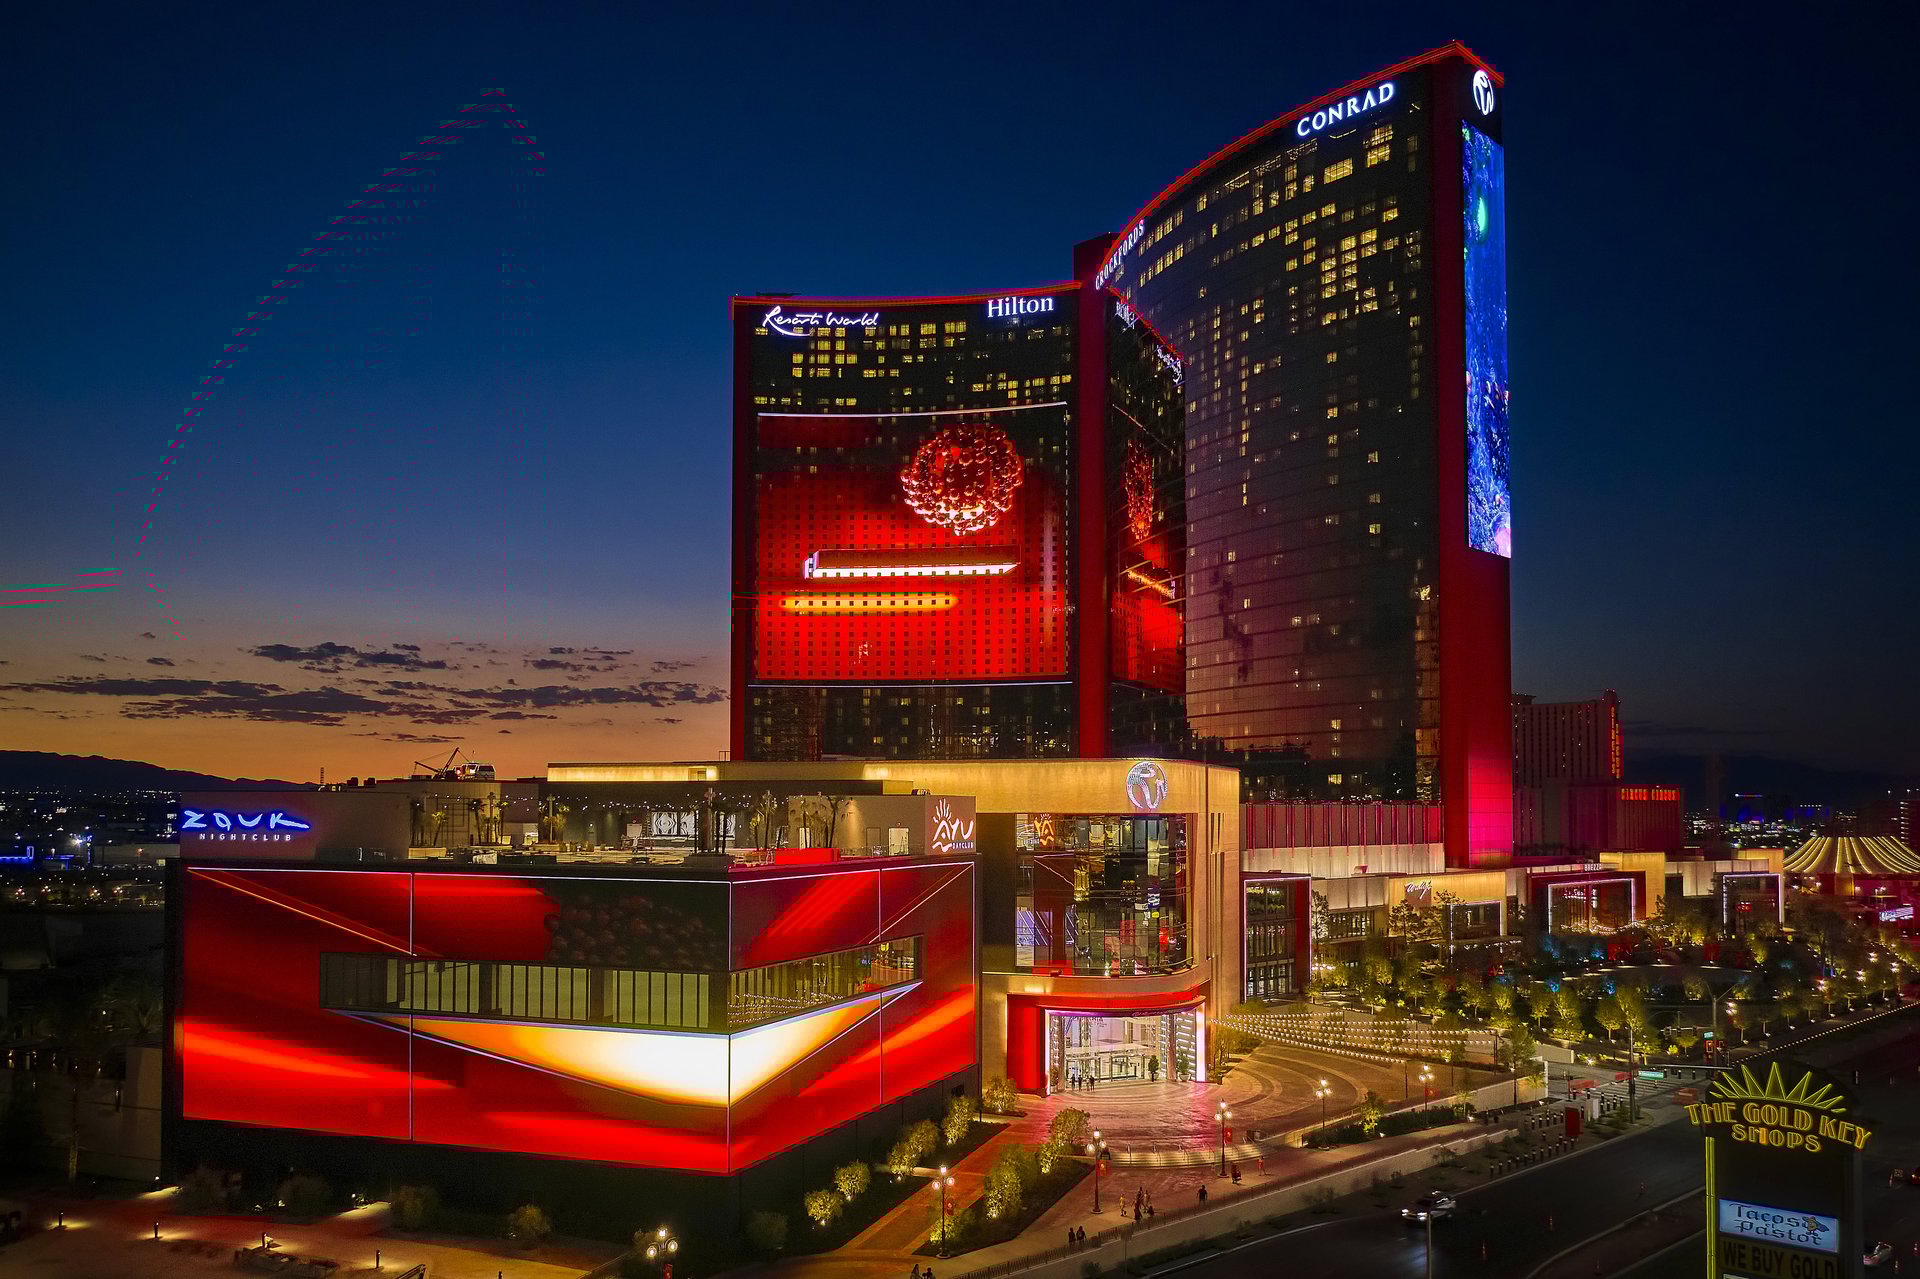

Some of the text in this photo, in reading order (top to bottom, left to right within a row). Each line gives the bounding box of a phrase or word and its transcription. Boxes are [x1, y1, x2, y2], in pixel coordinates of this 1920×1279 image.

[1297, 82, 1395, 137] CONRAD
[1095, 219, 1145, 290] CROCKFORDS
[762, 305, 879, 336] Resorts World
[987, 296, 1054, 318] Hilton
[1621, 788, 1677, 801] CIRCUS CIRCUS
[1684, 1102, 1872, 1149] THE GOLD KEY
[1731, 1124, 1821, 1152] SHOPS
[1729, 1204, 1800, 1228] Tacos
[1733, 1219, 1822, 1245] Pastor
[1722, 1241, 1746, 1269] WE
[1751, 1245, 1784, 1275] BUY
